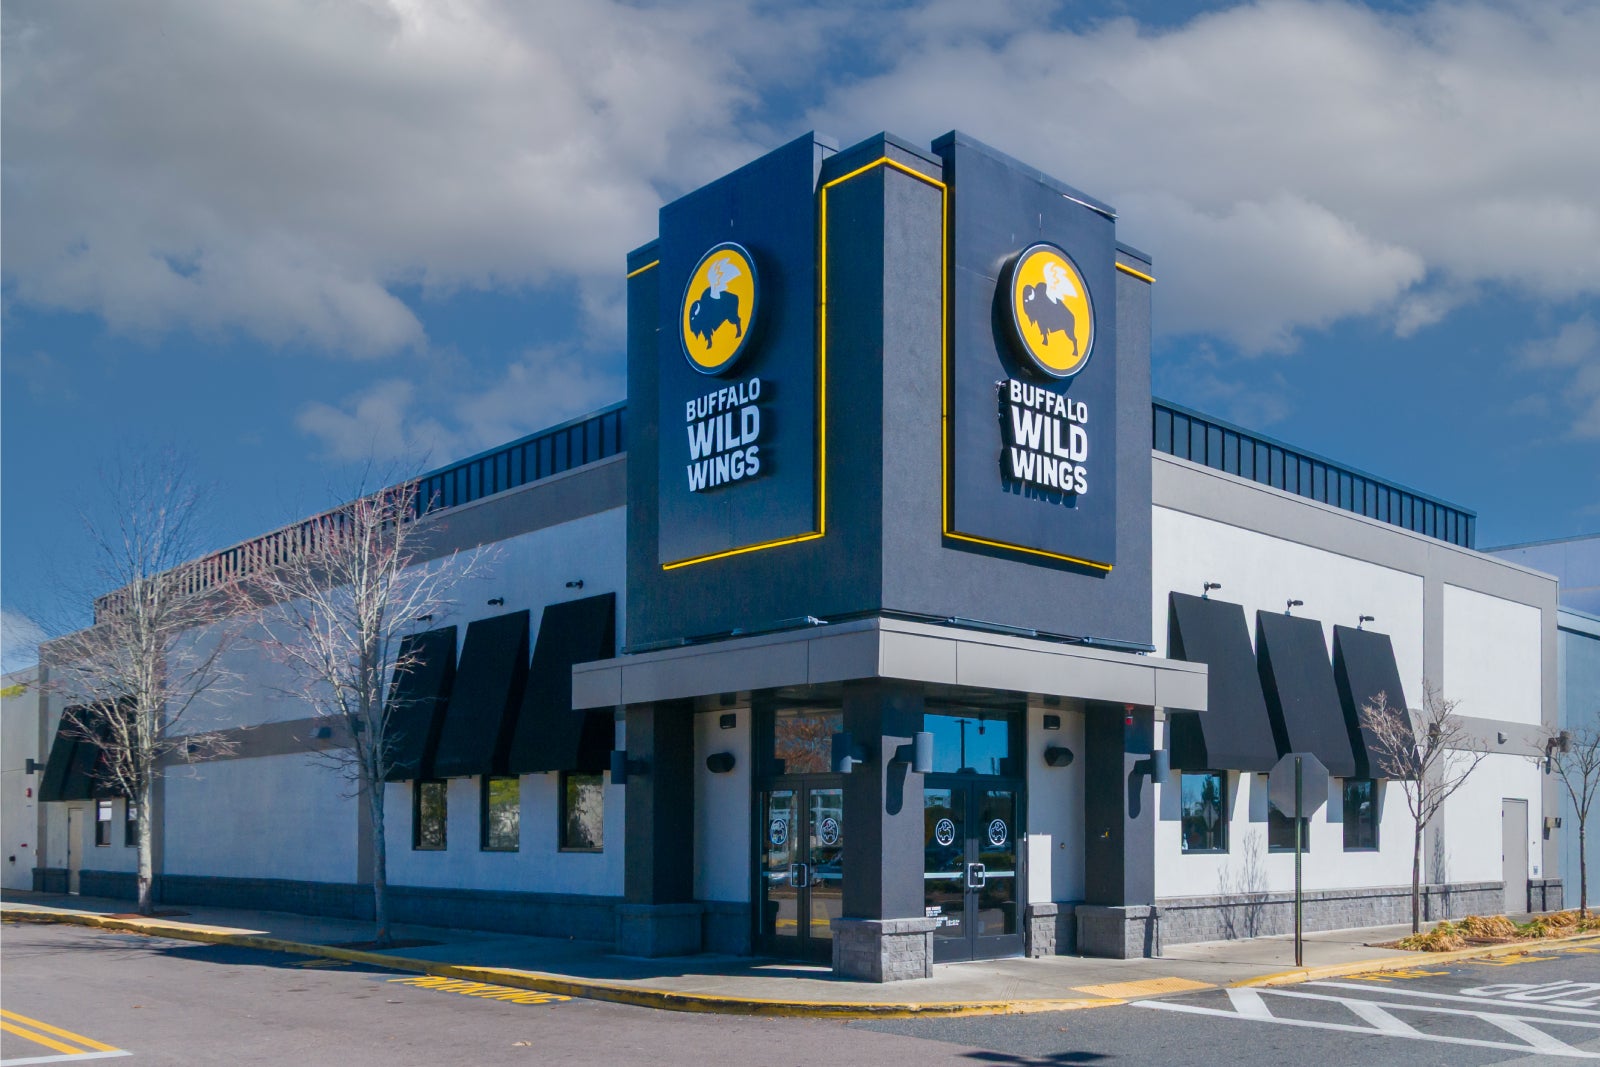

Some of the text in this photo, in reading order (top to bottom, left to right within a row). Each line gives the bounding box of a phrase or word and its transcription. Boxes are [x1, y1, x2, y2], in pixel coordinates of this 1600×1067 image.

[686, 377, 760, 422] BUFFALO
[1010, 379, 1088, 424] BUFFALO
[687, 405, 760, 460] WILD
[1011, 405, 1088, 462] WILD
[687, 445, 760, 492] WINGS
[1010, 447, 1088, 495] WINGS
[386, 976, 573, 1005] PARKING
